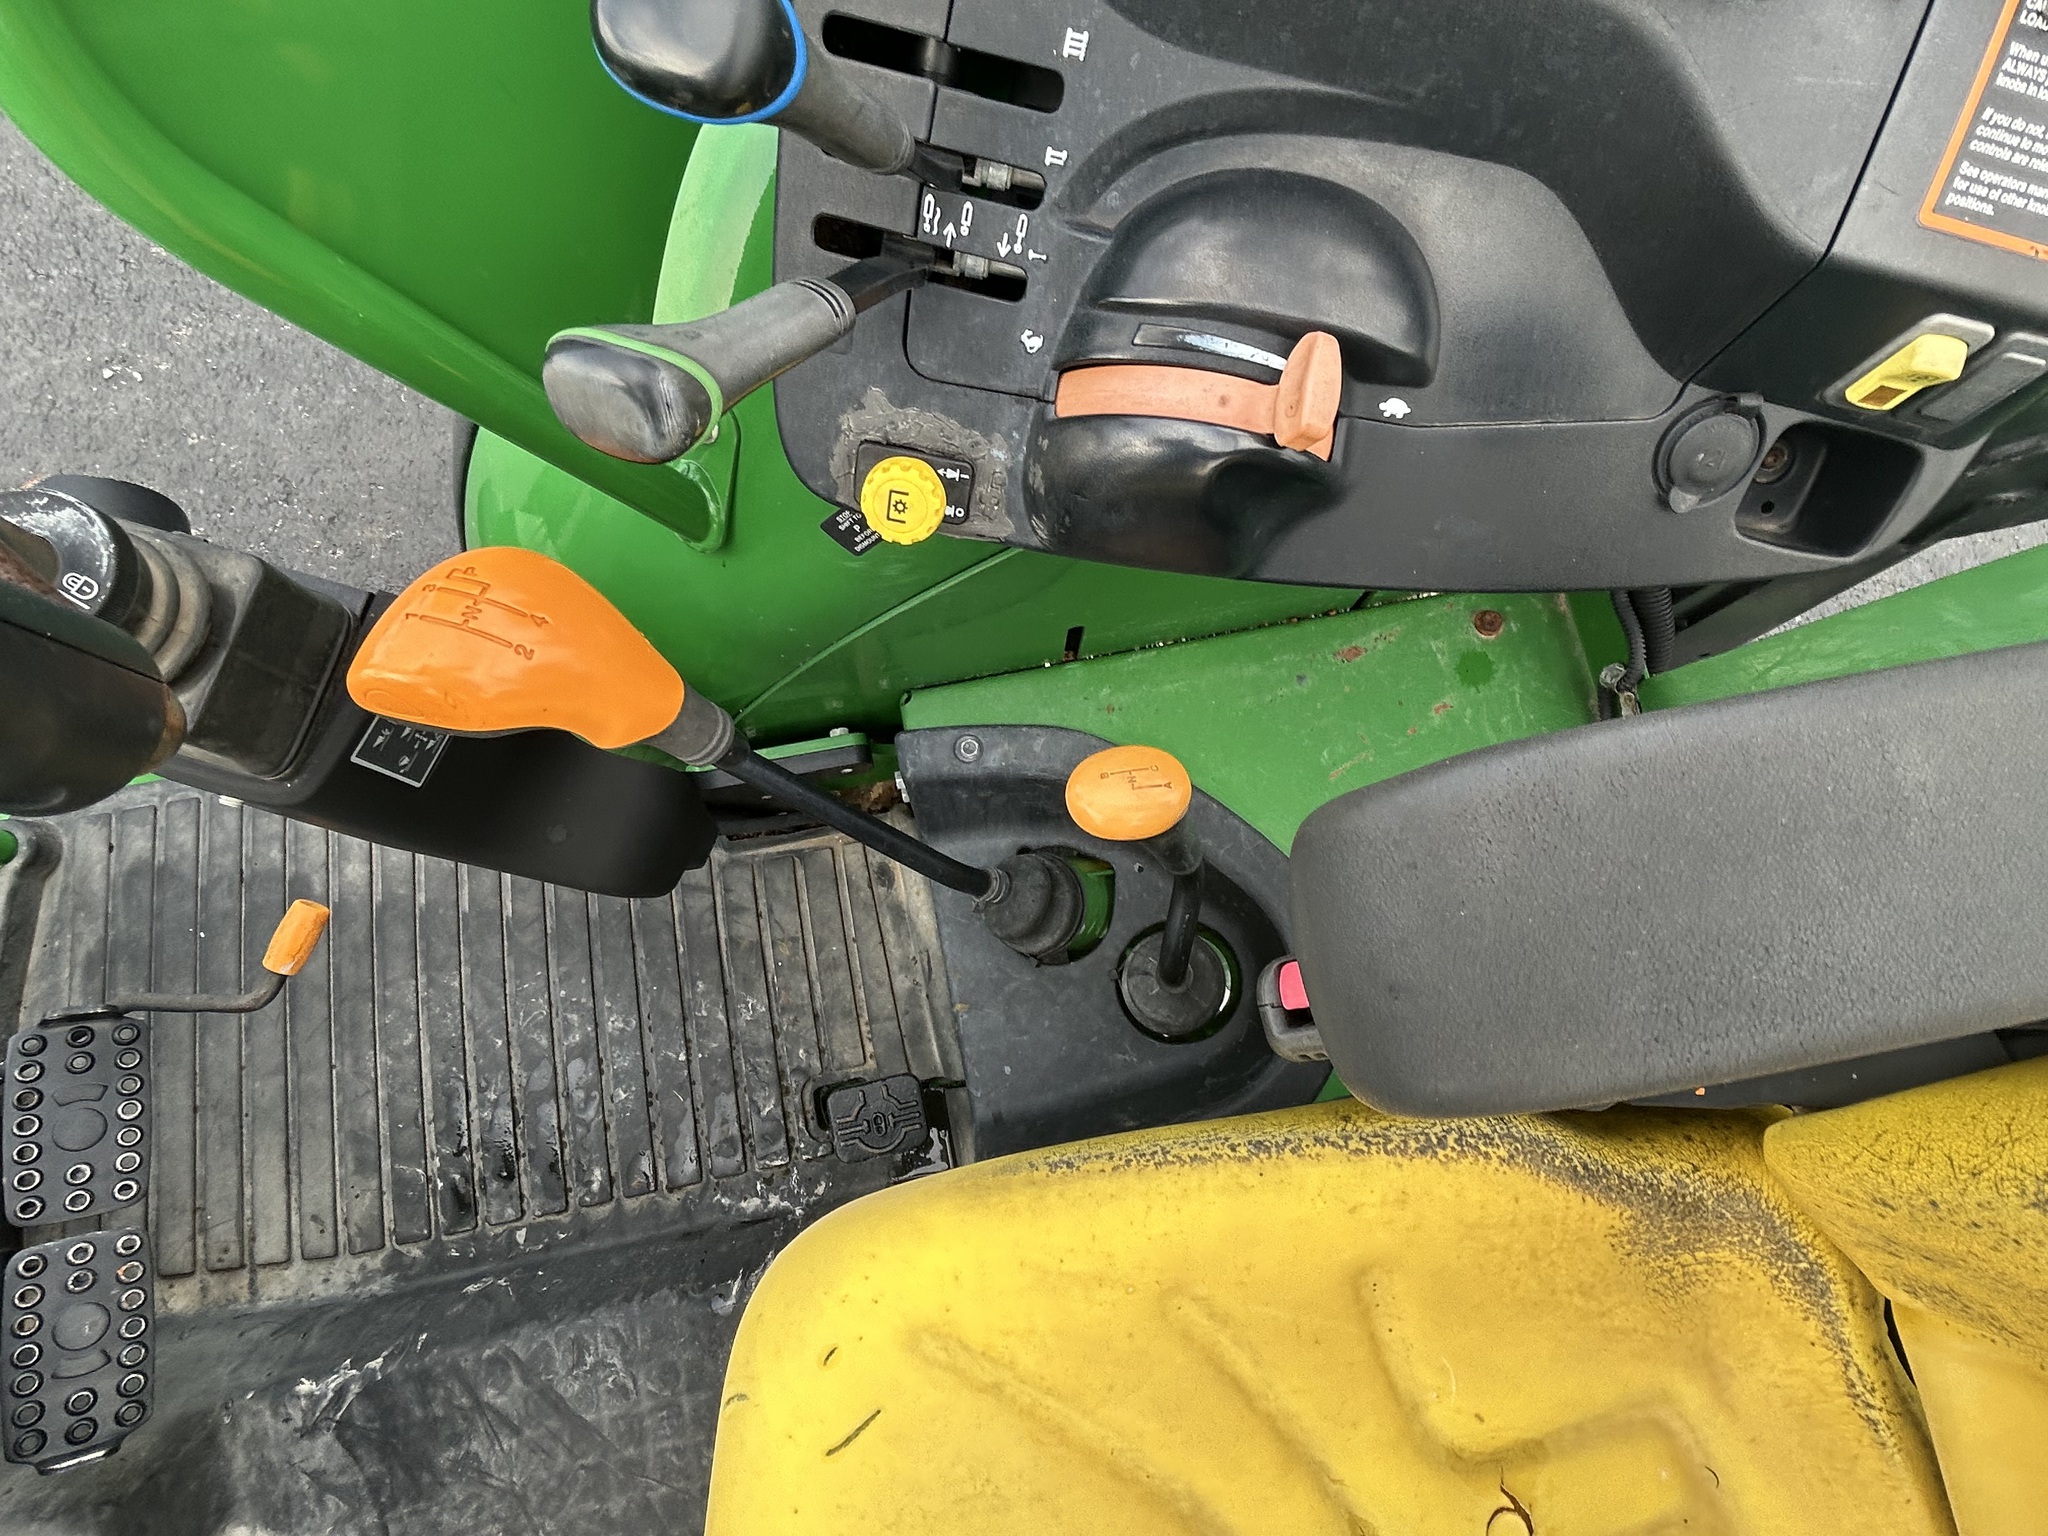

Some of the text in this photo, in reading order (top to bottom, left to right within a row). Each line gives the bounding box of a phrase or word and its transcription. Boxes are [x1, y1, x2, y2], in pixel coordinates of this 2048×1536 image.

[2009, 41, 2041, 63] When
[2001, 57, 2048, 83] ALWAYS
[1995, 71, 2028, 94] knobs
[2026, 81, 2038, 97] in
[1981, 106, 1995, 121] If
[1989, 112, 2012, 127] you
[2010, 117, 2027, 132] do
[1976, 124, 2021, 147] continue
[2019, 136, 2033, 151] to
[1969, 139, 2013, 161] controls
[2010, 152, 2030, 166] are
[1959, 160, 1980, 178] See
[1979, 169, 2028, 193] operators
[1944, 192, 1994, 216] positions.
[1953, 176, 1970, 191] for
[1968, 183, 1989, 197] use
[1988, 188, 2003, 201] of
[2000, 192, 2029, 209] other
[852, 524, 861, 533] P
[530, 614, 550, 627] 4
[514, 644, 535, 660] 2
[1163, 781, 1173, 789] A
